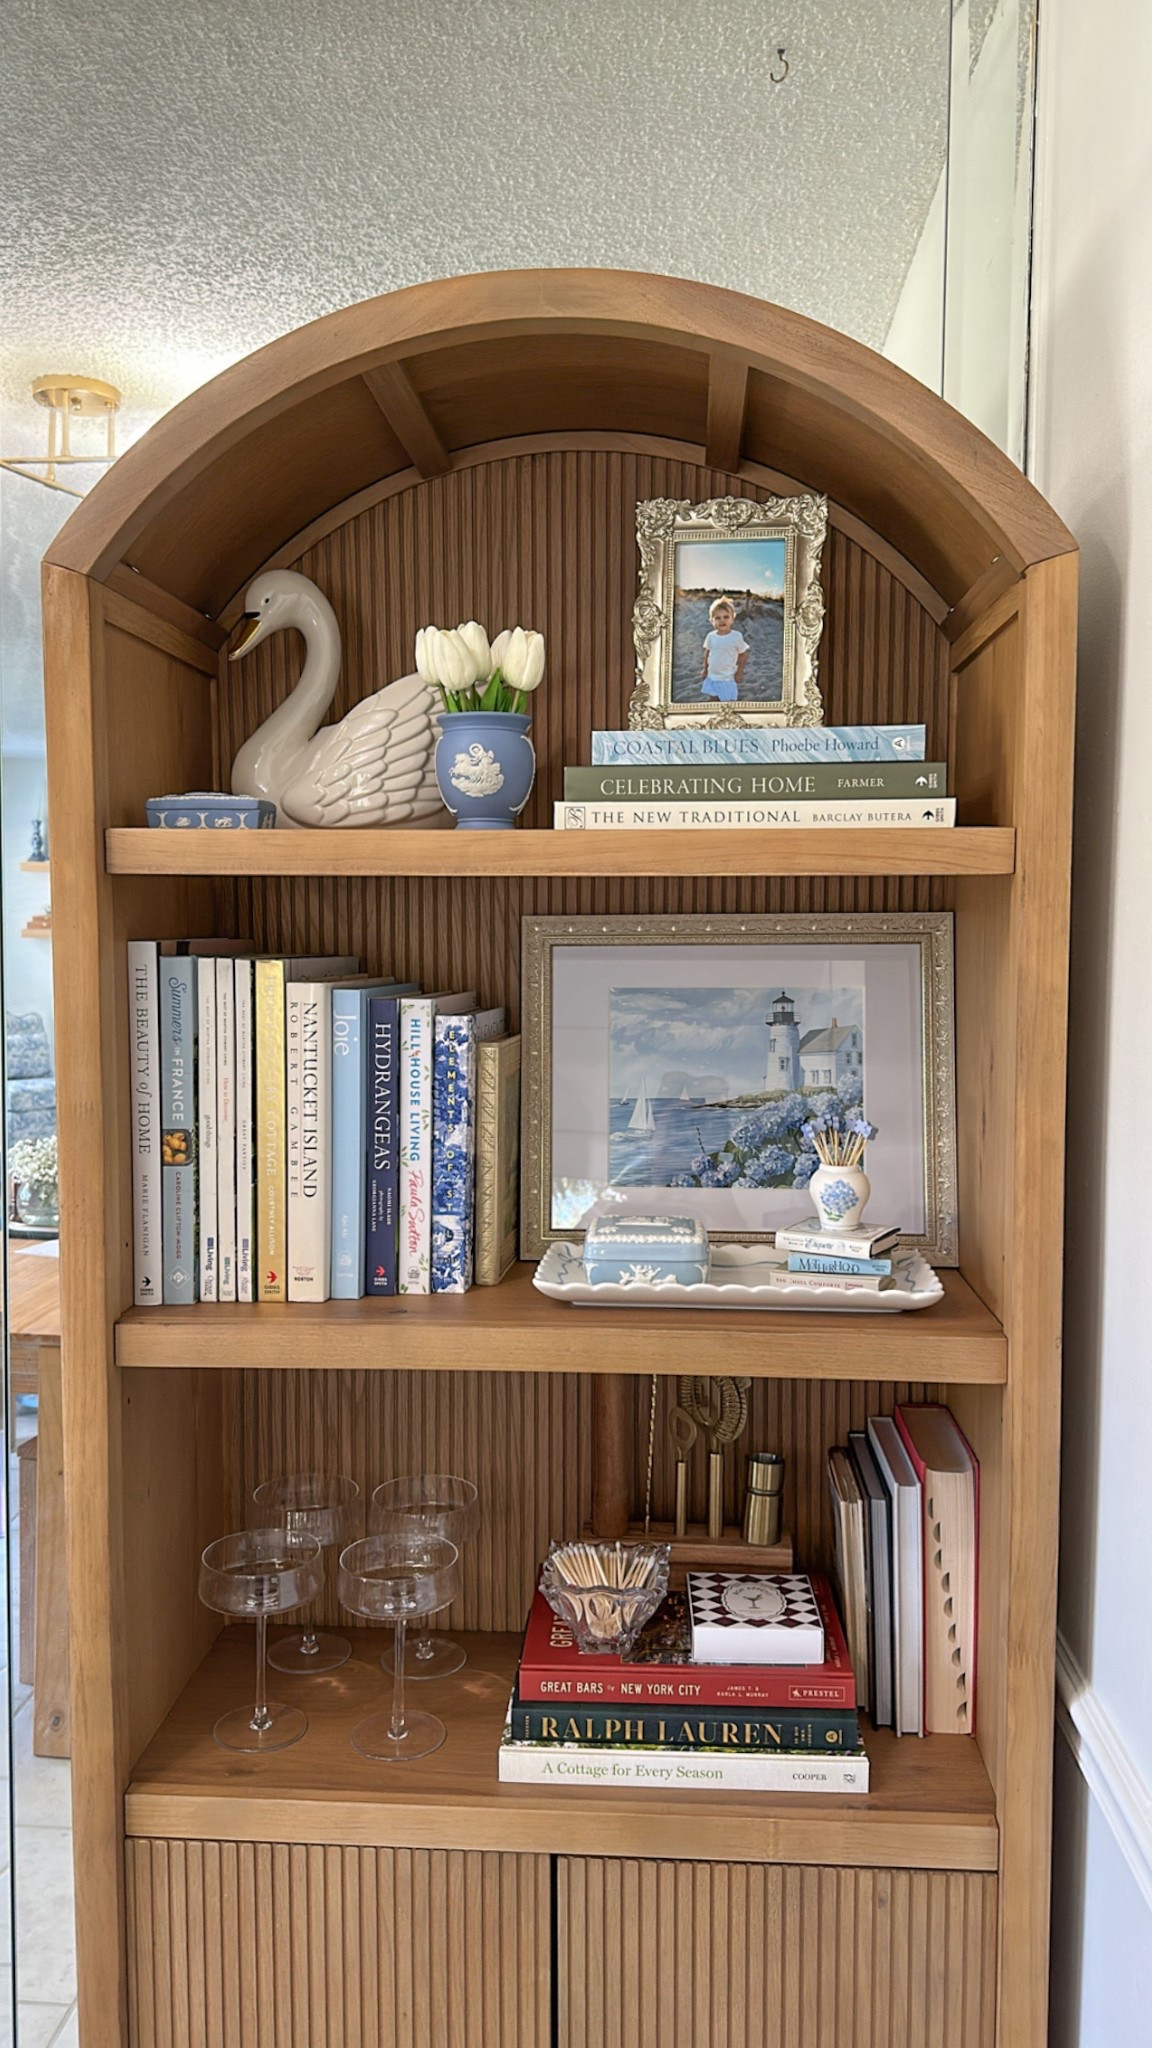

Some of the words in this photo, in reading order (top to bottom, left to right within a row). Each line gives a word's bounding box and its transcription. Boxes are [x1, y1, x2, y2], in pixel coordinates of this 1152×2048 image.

[613, 740, 697, 755] COASTAL
[703, 739, 759, 753] BLUES
[772, 738, 819, 753] Phoebe
[825, 736, 879, 751] Howard
[601, 778, 742, 795] CELEBRATING
[751, 777, 816, 793] HOME
[838, 778, 884, 788] FARMER
[591, 811, 624, 824] THE
[633, 812, 671, 823] NEW
[680, 811, 800, 823] TRADITIONAL
[813, 813, 861, 823] BARCLAY
[868, 812, 911, 821] BUTERA
[136, 964, 148, 1001] THE
[169, 977, 187, 1045] Summers
[333, 1011, 358, 1055] Joie
[137, 1008, 148, 1076] BEAUTY
[175, 1047, 180, 1055] IN
[290, 1002, 298, 1086] ROBERT
[411, 1019, 421, 1050] HILL
[302, 1002, 317, 1122] NANTUCKET
[410, 1058, 420, 1105] HOUSE
[447, 1030, 456, 1132] ELEMENTS
[137, 1083, 152, 1096] of
[172, 1059, 183, 1121] FRANCE
[374, 1023, 391, 1169] HYDRANGEAS
[138, 1103, 150, 1154] HOME
[266, 1111, 276, 1176] COTTAGE
[410, 1113, 420, 1161] LIVING
[290, 1107, 298, 1198] GAMBEE
[303, 1129, 317, 1198] ISLAND
[446, 1150, 455, 1172] OF
[408, 1170, 424, 1206] Paula
[408, 1209, 424, 1256] Sutton
[206, 1247, 214, 1270] Living
[799, 1258, 860, 1273] MOTHERHOOD
[541, 1682, 572, 1693] GREAT
[577, 1682, 603, 1693] BARS
[621, 1683, 642, 1694] NEW
[647, 1684, 674, 1695] YORK
[679, 1684, 700, 1695] CITY
[542, 1717, 643, 1740] RALPH
[659, 1720, 782, 1744] LAUREN
[542, 1764, 553, 1774] A
[557, 1763, 609, 1778] Cottage
[613, 1763, 631, 1776] for
[636, 1765, 671, 1780] Every
[676, 1767, 723, 1779] Season
